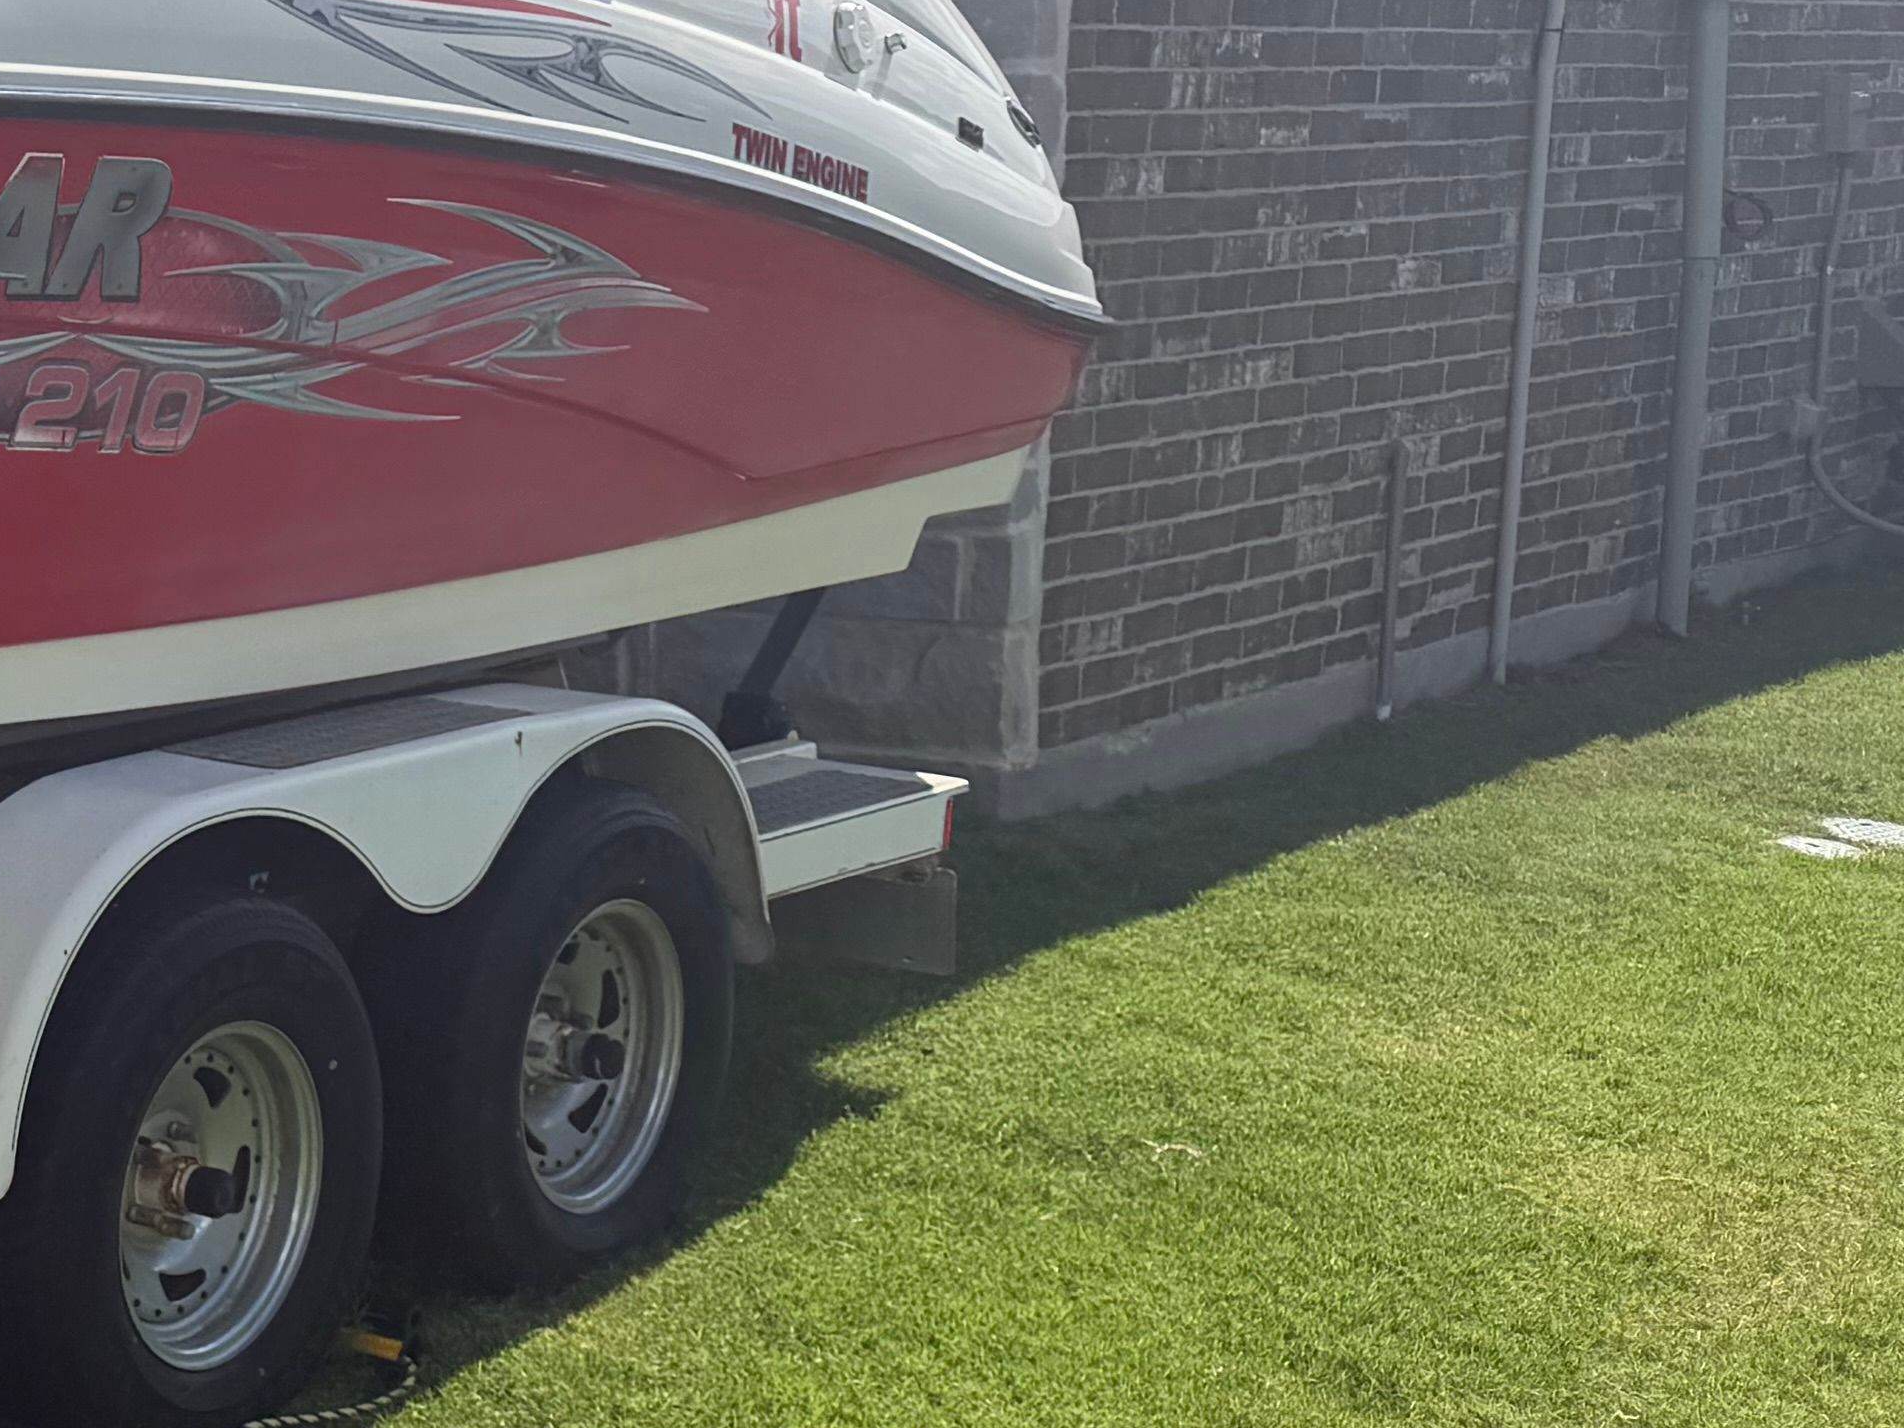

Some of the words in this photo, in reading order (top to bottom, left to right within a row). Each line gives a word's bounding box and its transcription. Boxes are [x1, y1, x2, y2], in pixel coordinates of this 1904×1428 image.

[732, 123, 788, 174] TWIN
[792, 142, 869, 204] ENGINE
[5, 364, 205, 455] 210
